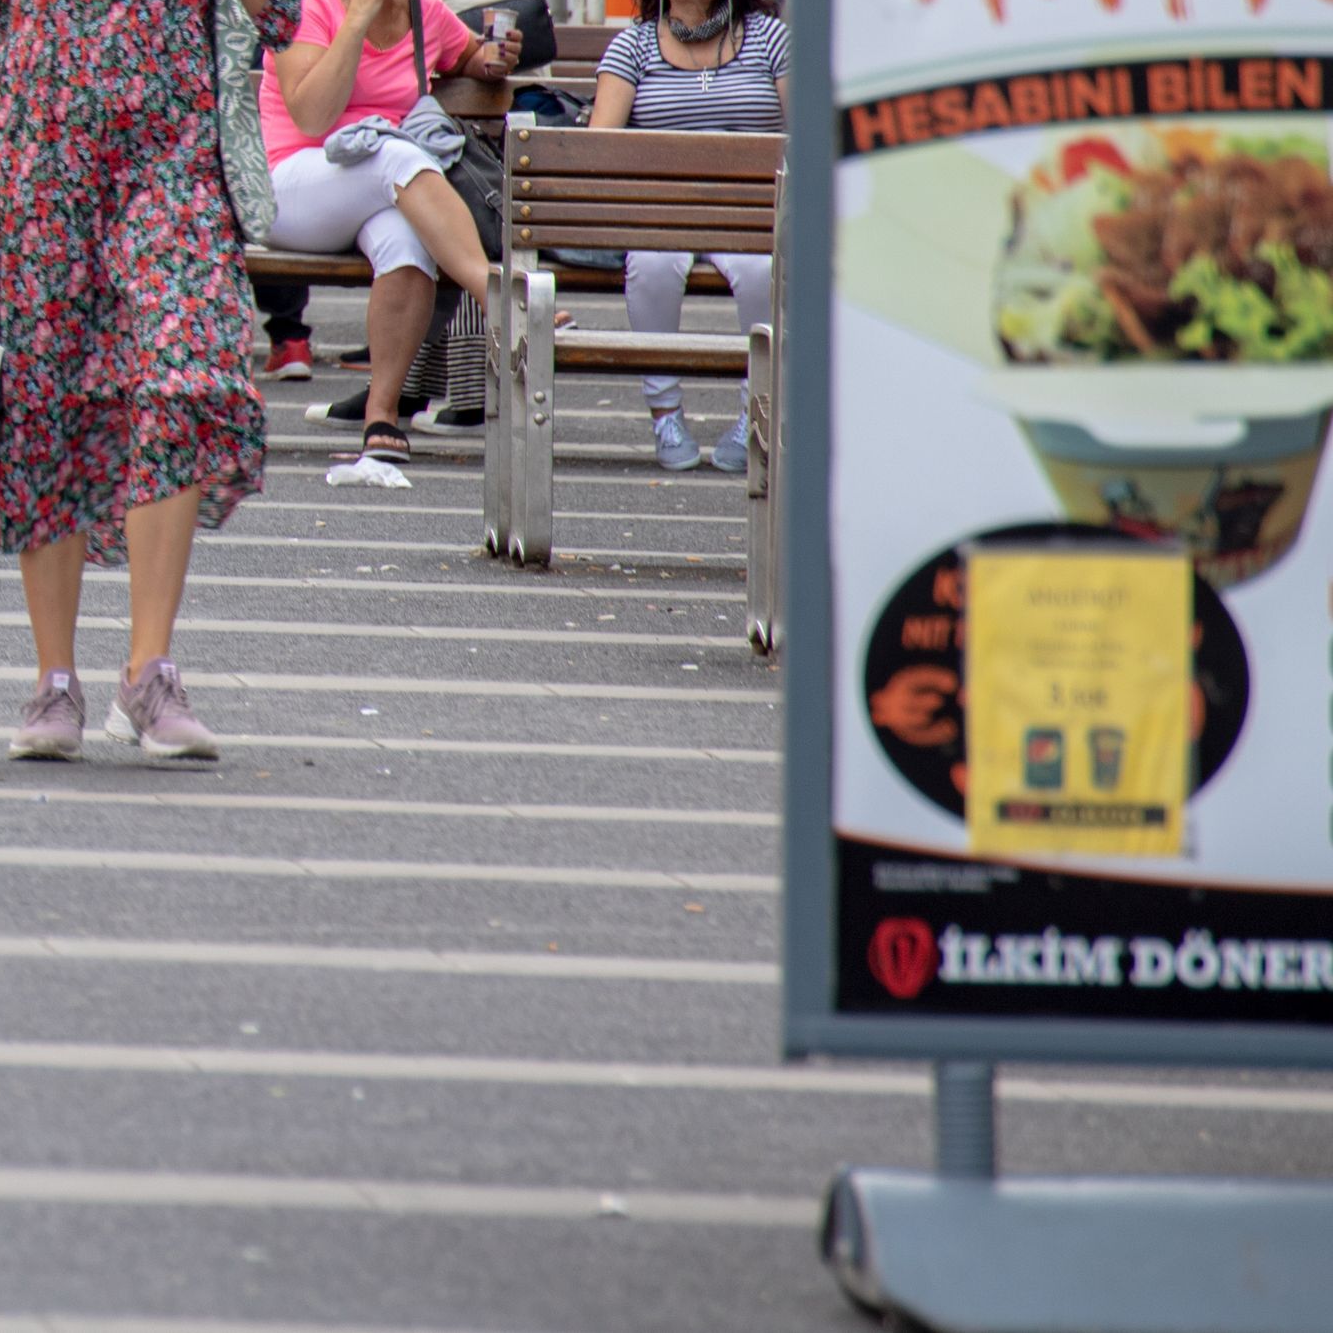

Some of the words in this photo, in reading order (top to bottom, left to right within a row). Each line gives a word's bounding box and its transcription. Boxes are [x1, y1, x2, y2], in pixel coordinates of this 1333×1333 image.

[849, 66, 1132, 152] HESABINI
[1145, 54, 1323, 114] BİLEN
[937, 923, 1123, 987] İLKİM
